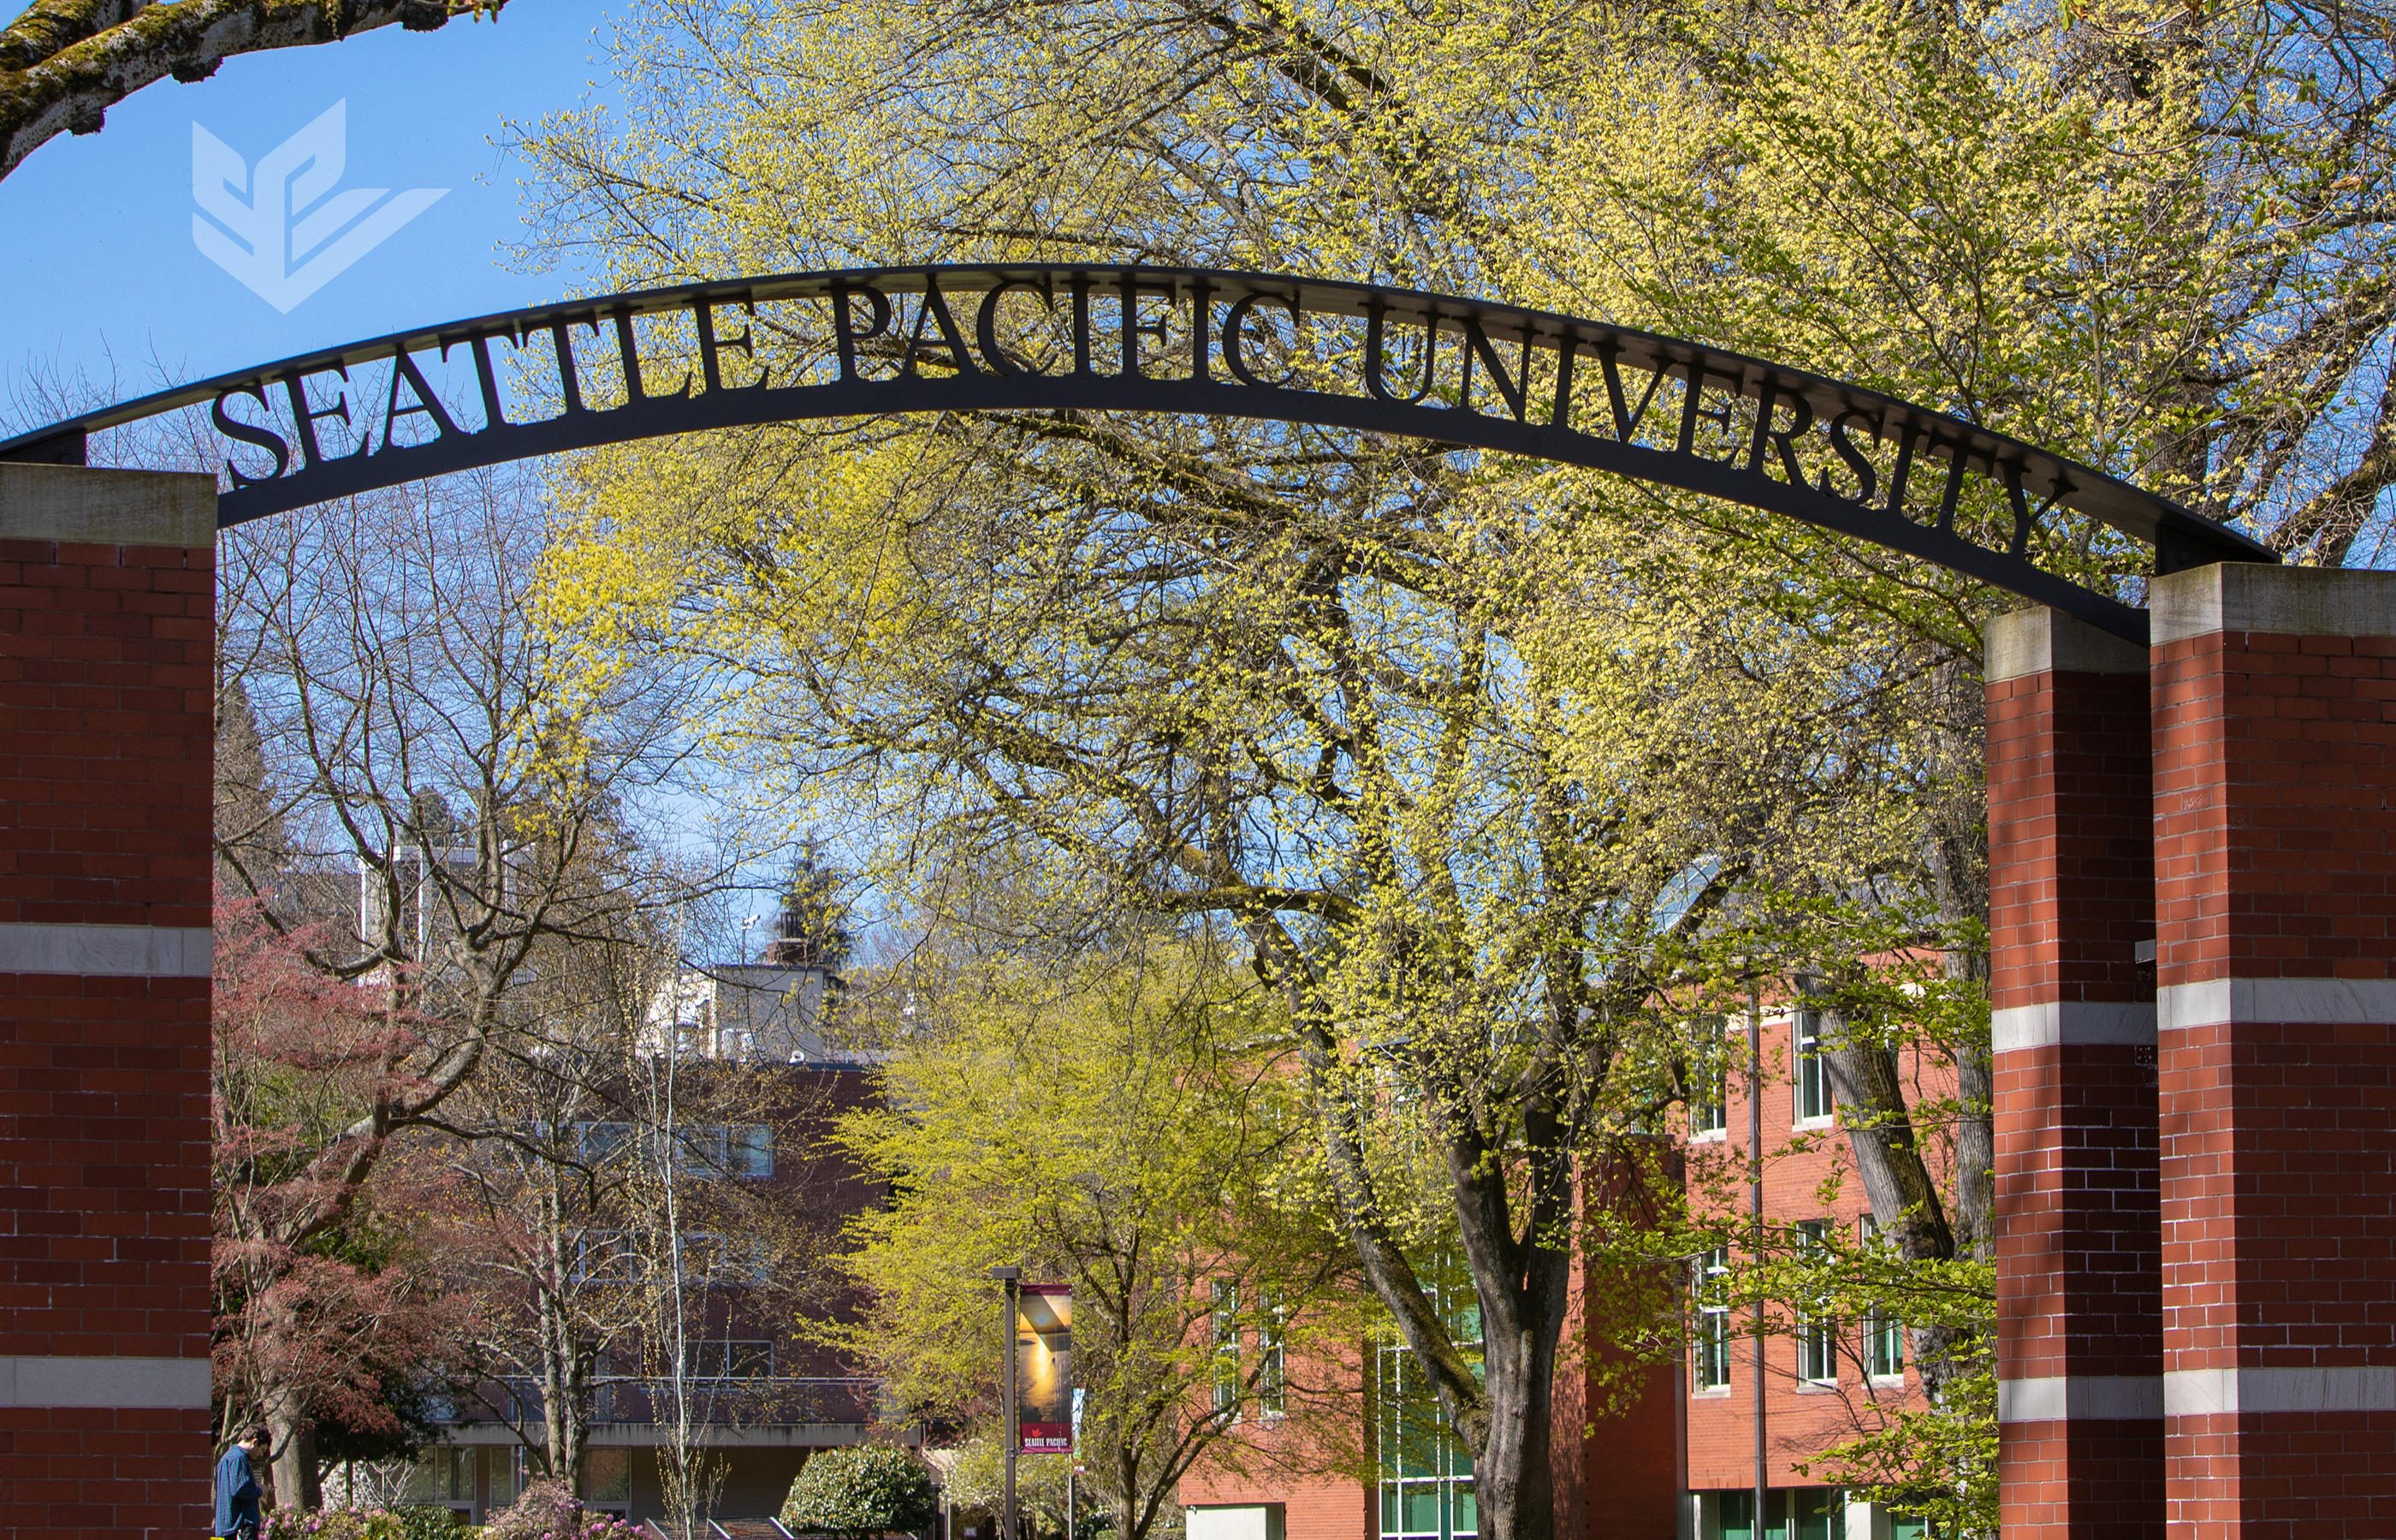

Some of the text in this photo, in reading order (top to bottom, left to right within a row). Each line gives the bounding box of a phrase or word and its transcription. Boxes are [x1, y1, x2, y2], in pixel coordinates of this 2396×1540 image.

[211, 274, 2079, 556] SEATTLE PACIFIC UNIVERSITY
[1024, 1437, 1068, 1447] SEATTLE PACIFIC
